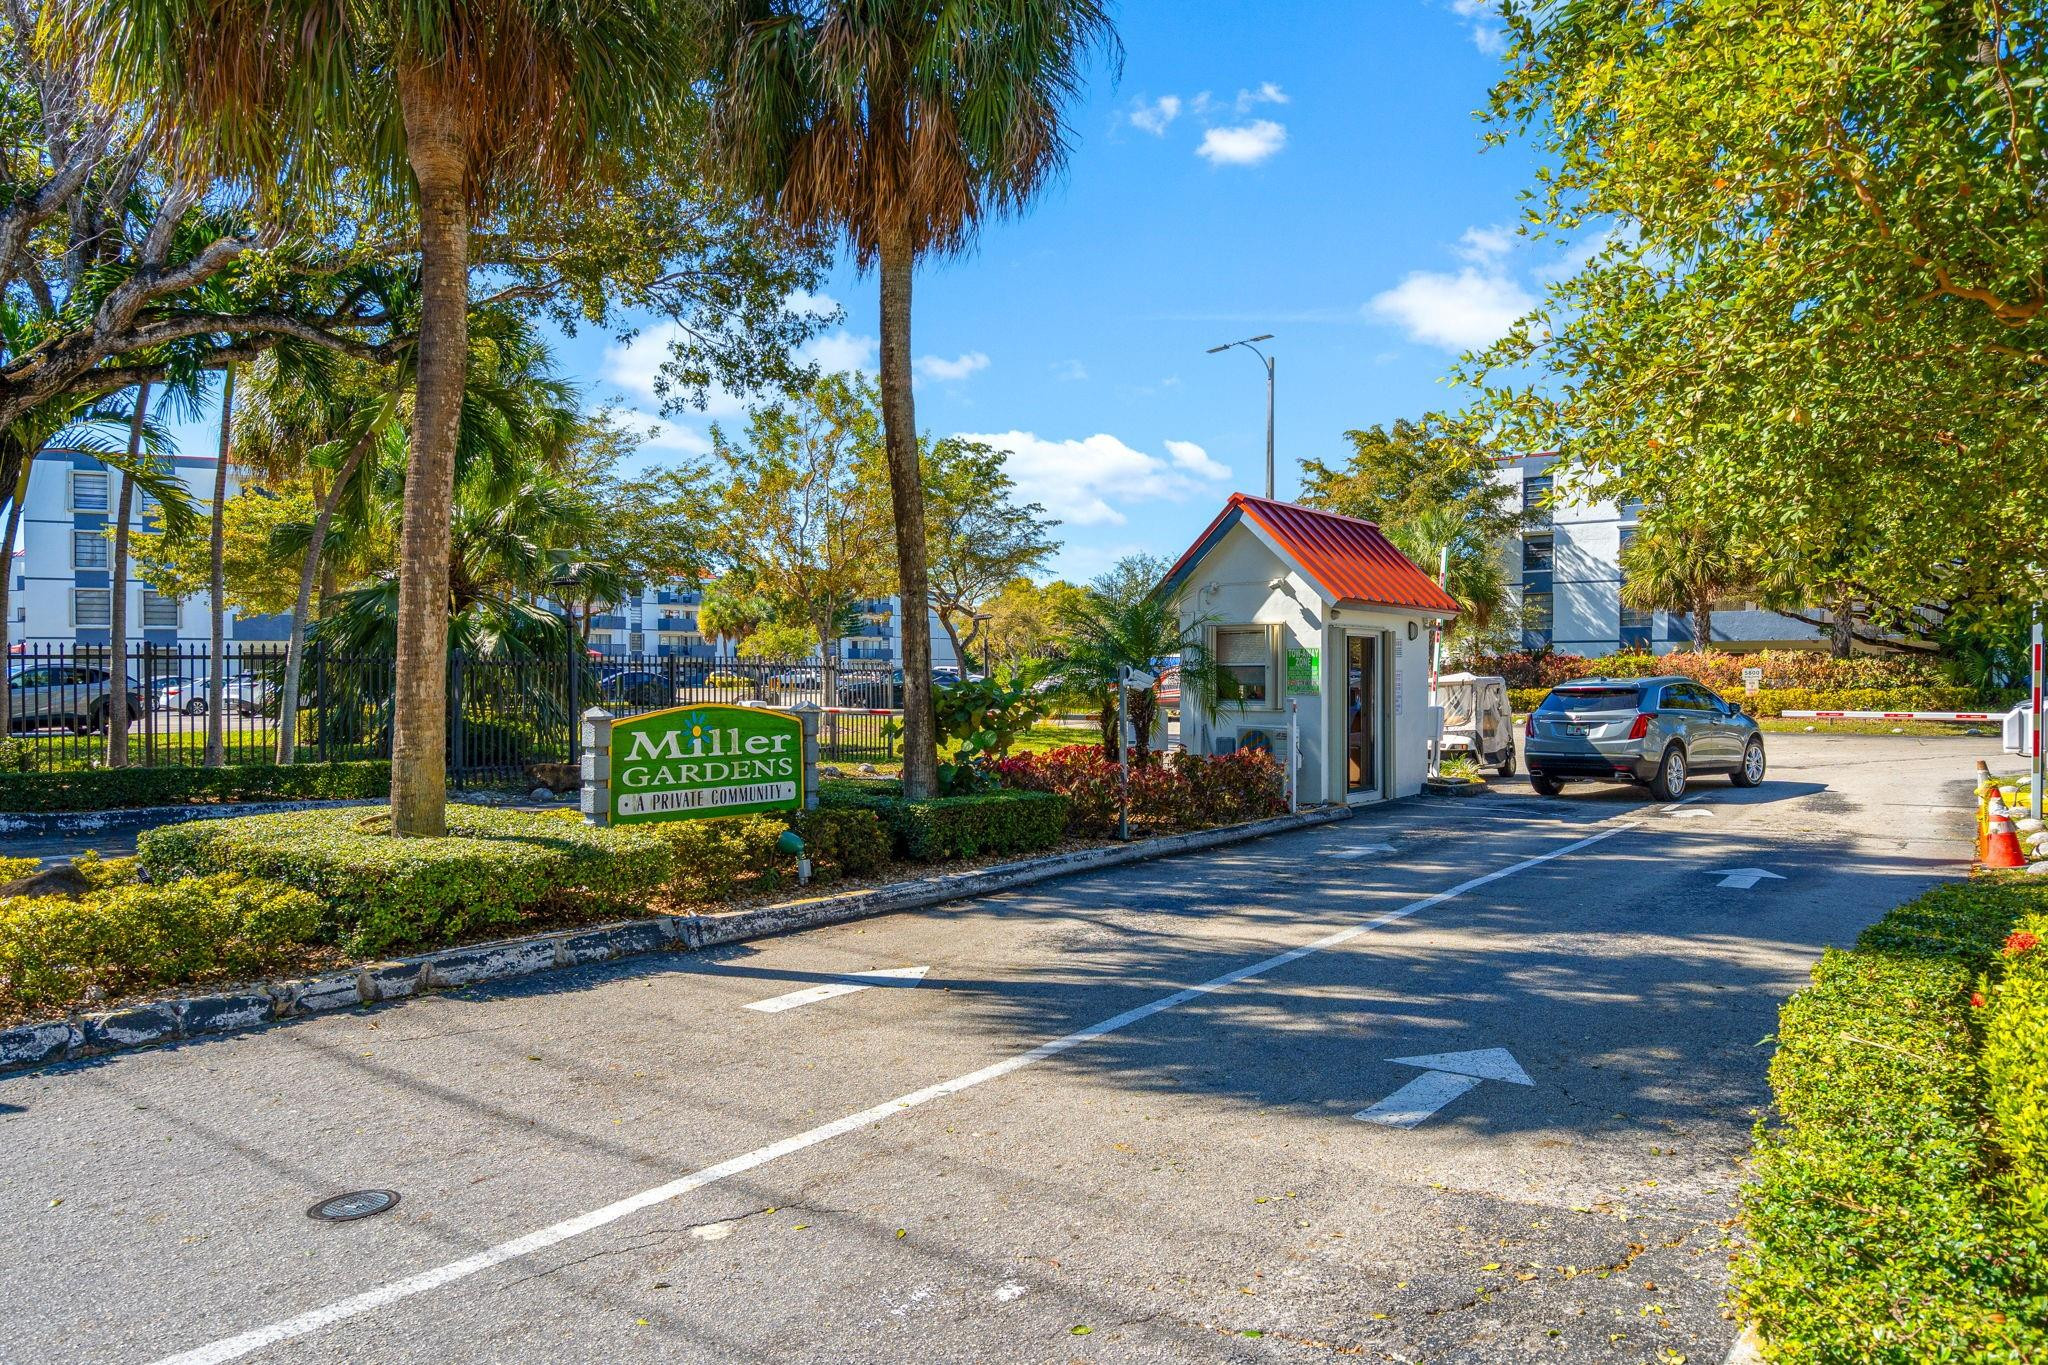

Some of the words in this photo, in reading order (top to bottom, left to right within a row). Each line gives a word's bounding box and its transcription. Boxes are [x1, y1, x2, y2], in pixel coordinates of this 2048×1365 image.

[624, 727, 792, 761] Miller
[622, 758, 793, 787] GARDENS
[636, 795, 645, 811] A
[652, 791, 704, 811] PRIVATE
[711, 784, 782, 805] COMMUNITY
